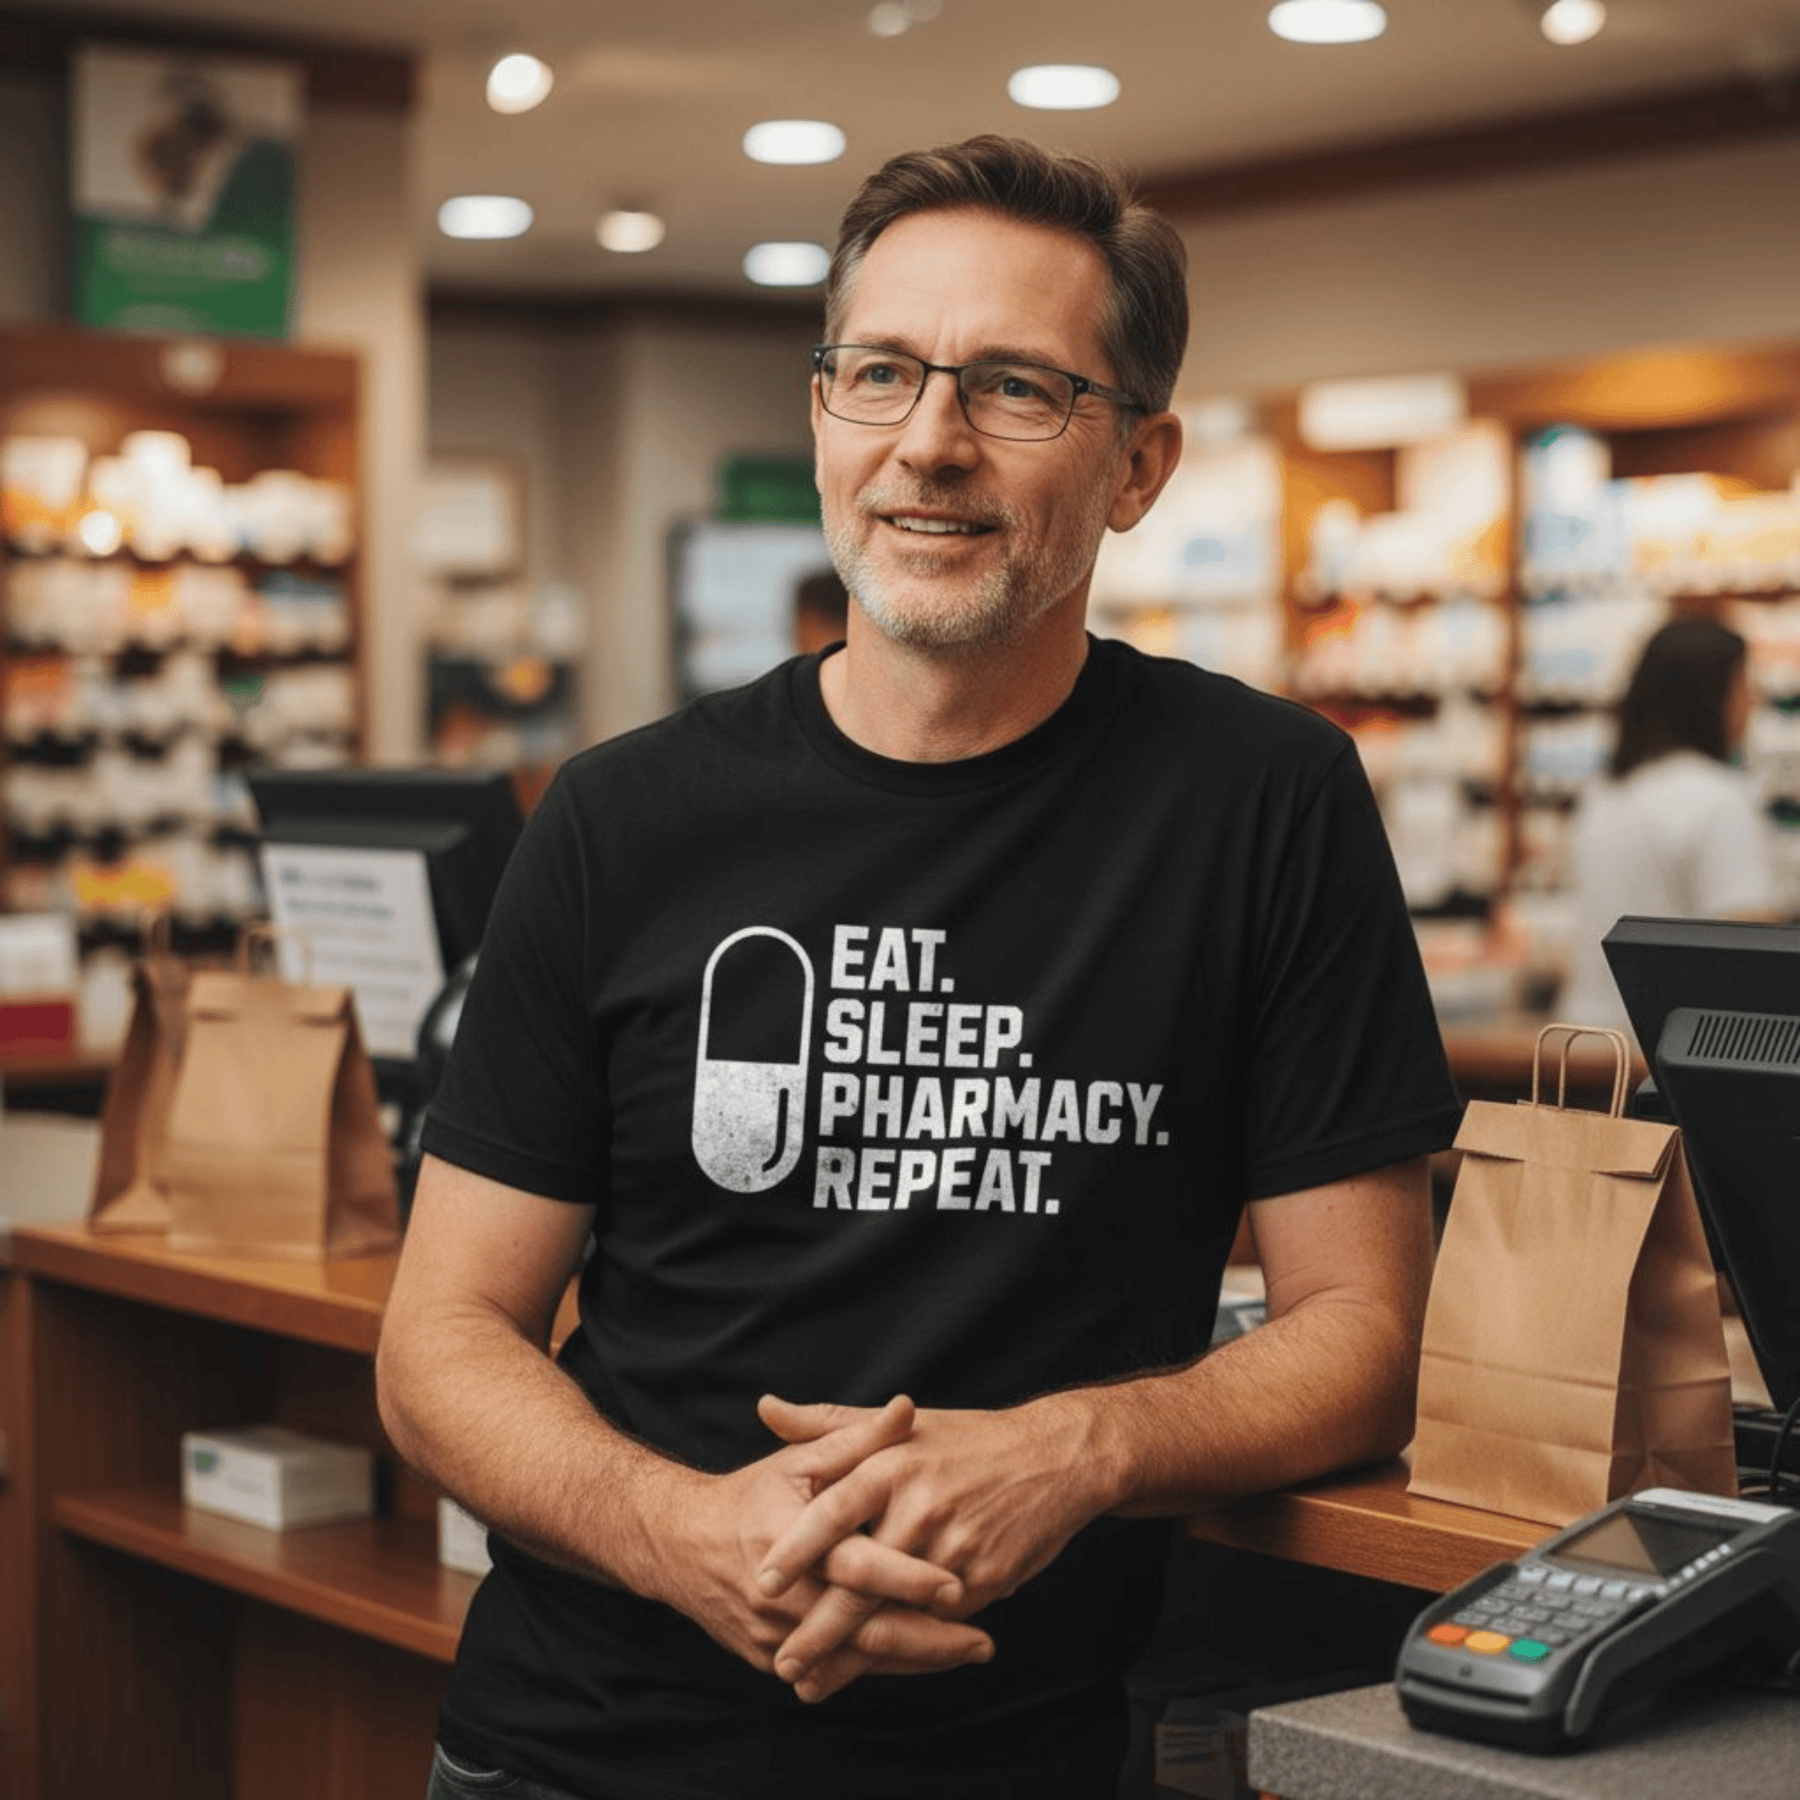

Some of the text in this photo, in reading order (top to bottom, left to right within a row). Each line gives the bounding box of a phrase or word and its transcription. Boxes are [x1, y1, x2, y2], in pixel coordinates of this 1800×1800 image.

[831, 924, 955, 992] EAT.
[824, 998, 1032, 1068] SLEEP.
[819, 1072, 1169, 1145] PHARMACY.
[813, 1146, 1060, 1214] REPEAT.
